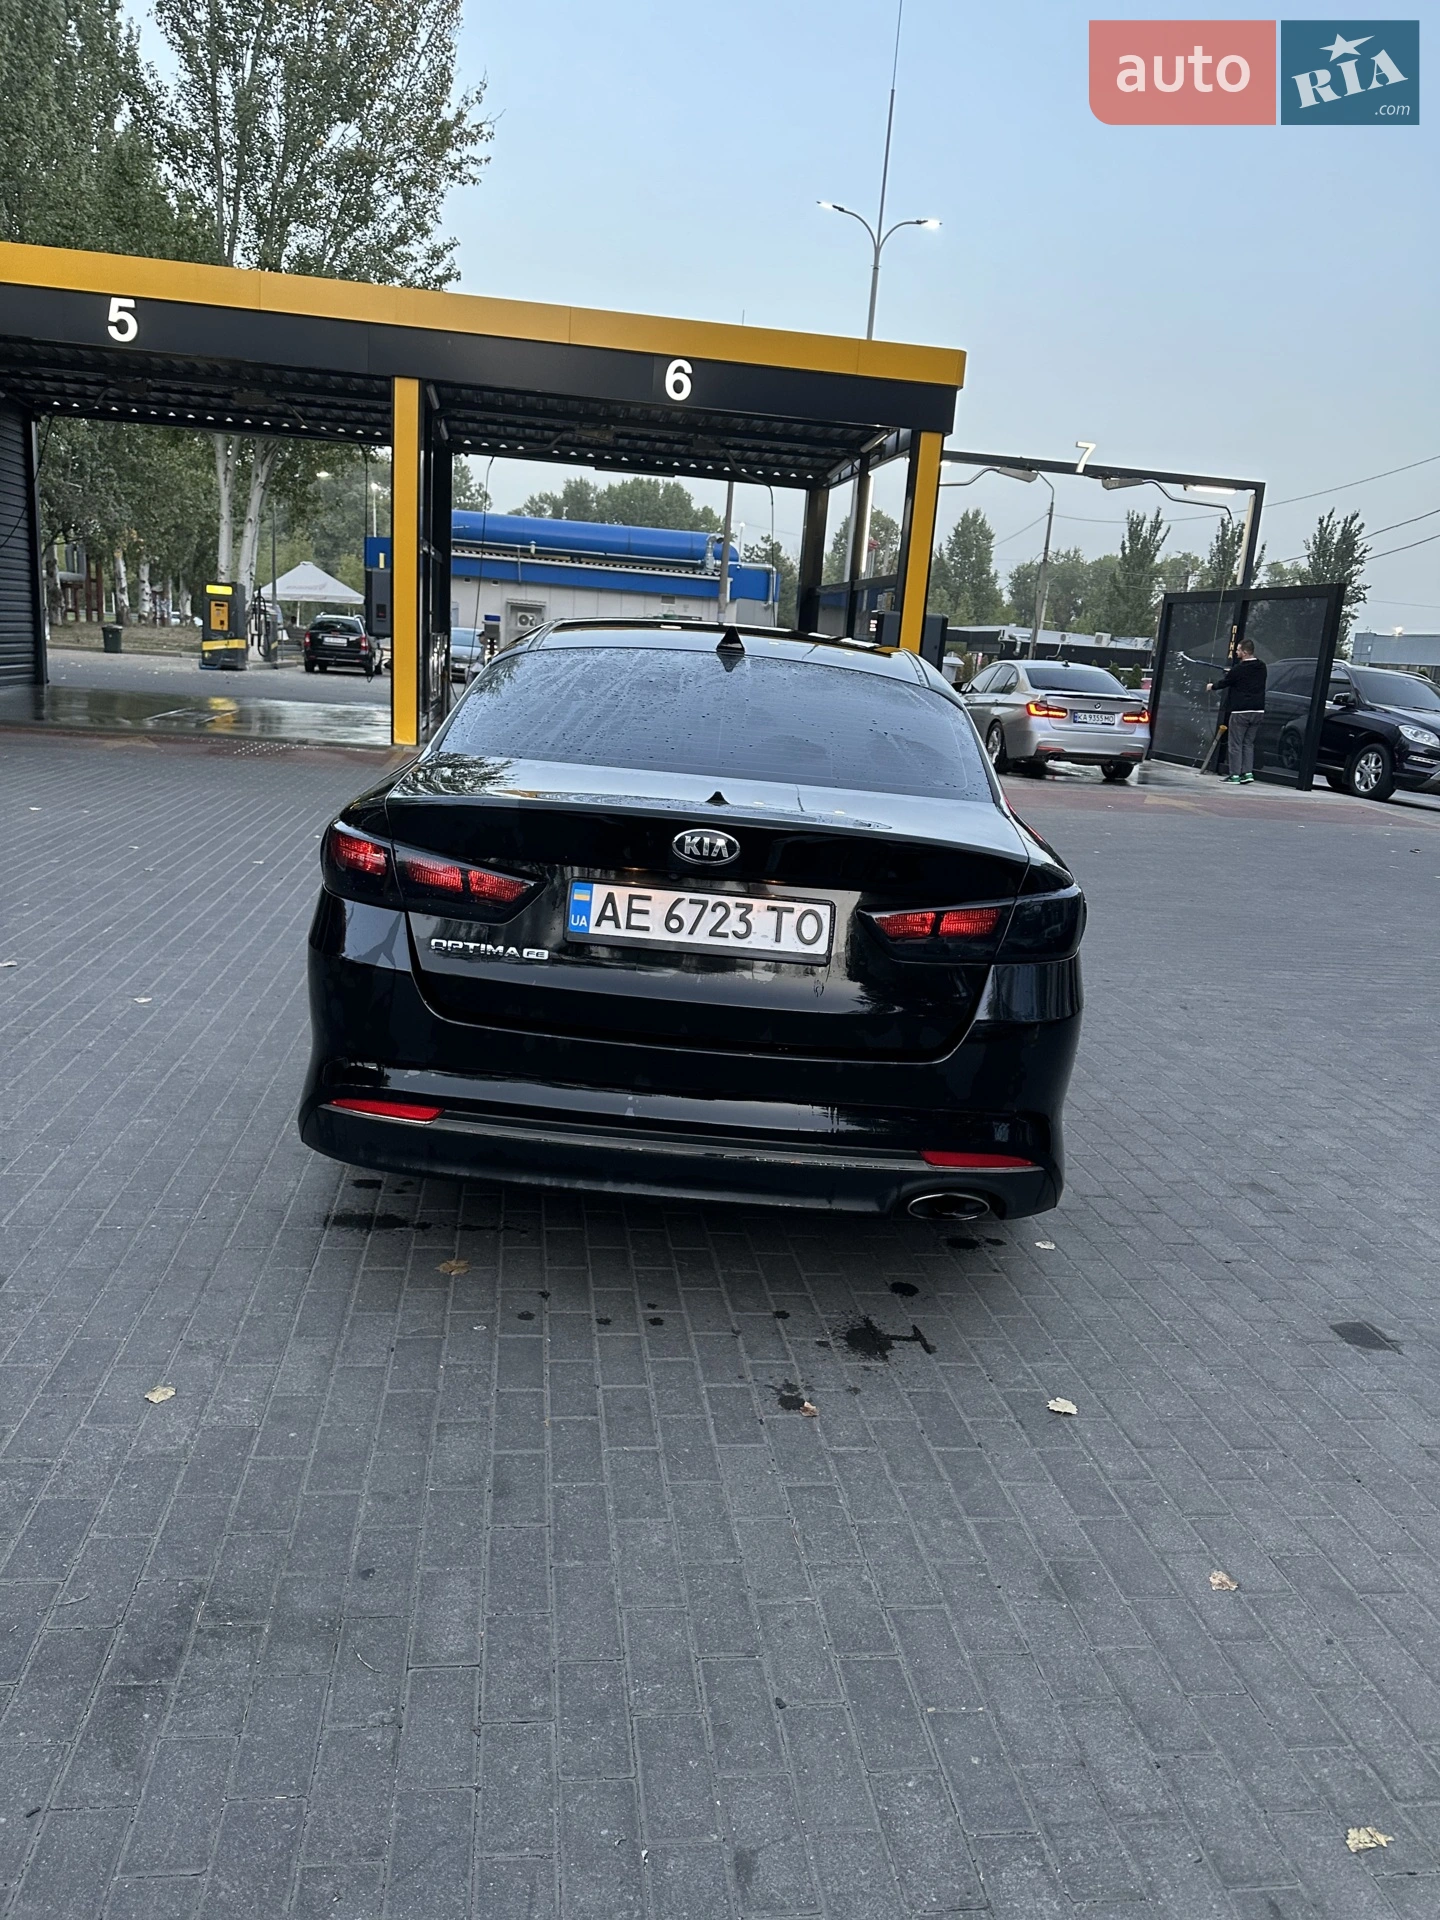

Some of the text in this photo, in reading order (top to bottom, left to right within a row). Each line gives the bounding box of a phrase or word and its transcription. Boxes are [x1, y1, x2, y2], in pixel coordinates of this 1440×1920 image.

[107, 296, 139, 343] 5
[665, 359, 693, 401] 6
[1075, 441, 1097, 473] 7
[1088, 714, 1104, 722] 9355
[684, 835, 729, 857] KIA
[571, 914, 588, 927] UA
[595, 891, 823, 945] AE 6723 TO
[430, 938, 521, 958] OPTIMA
